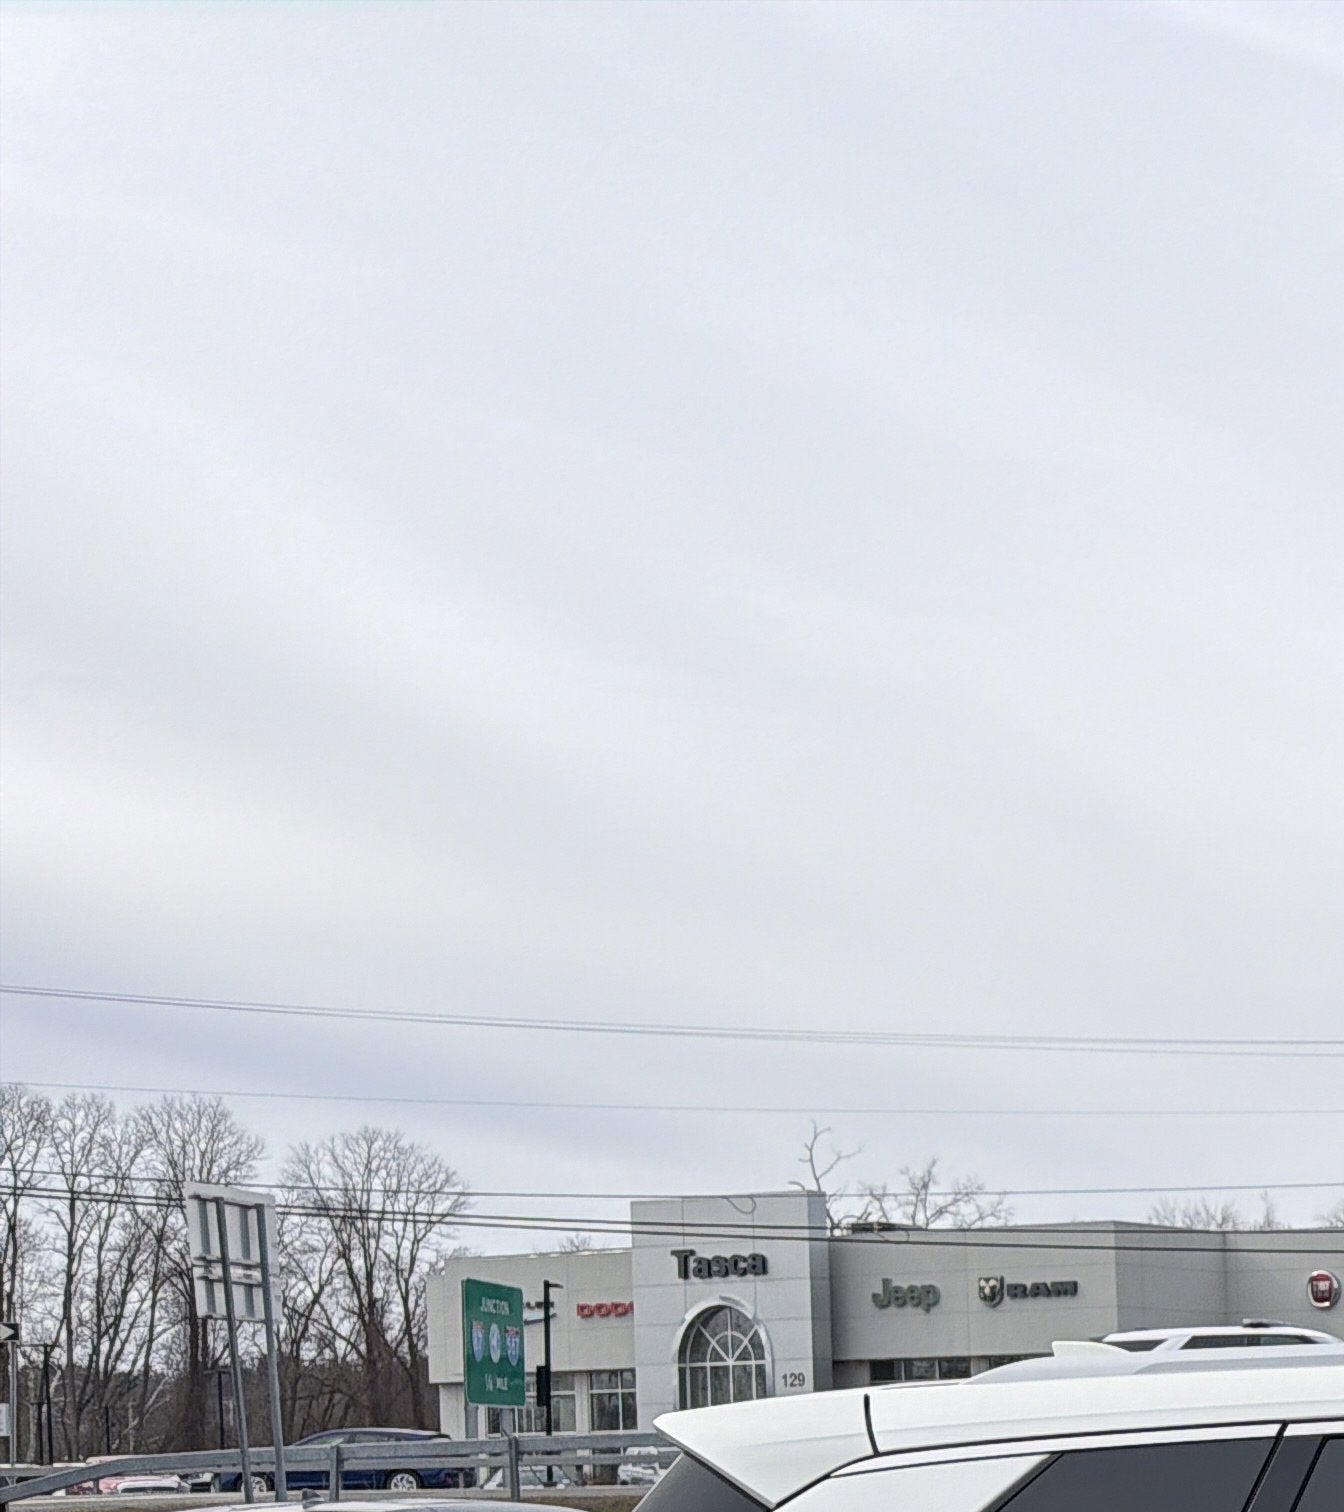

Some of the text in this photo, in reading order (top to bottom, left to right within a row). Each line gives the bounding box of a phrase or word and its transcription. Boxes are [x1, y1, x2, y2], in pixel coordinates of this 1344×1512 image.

[670, 1248, 769, 1280] Tasca
[872, 1277, 941, 1313] Jeep
[1006, 1280, 1079, 1299] RAM
[576, 1300, 634, 1319] DOD
[781, 1371, 806, 1388] 129
